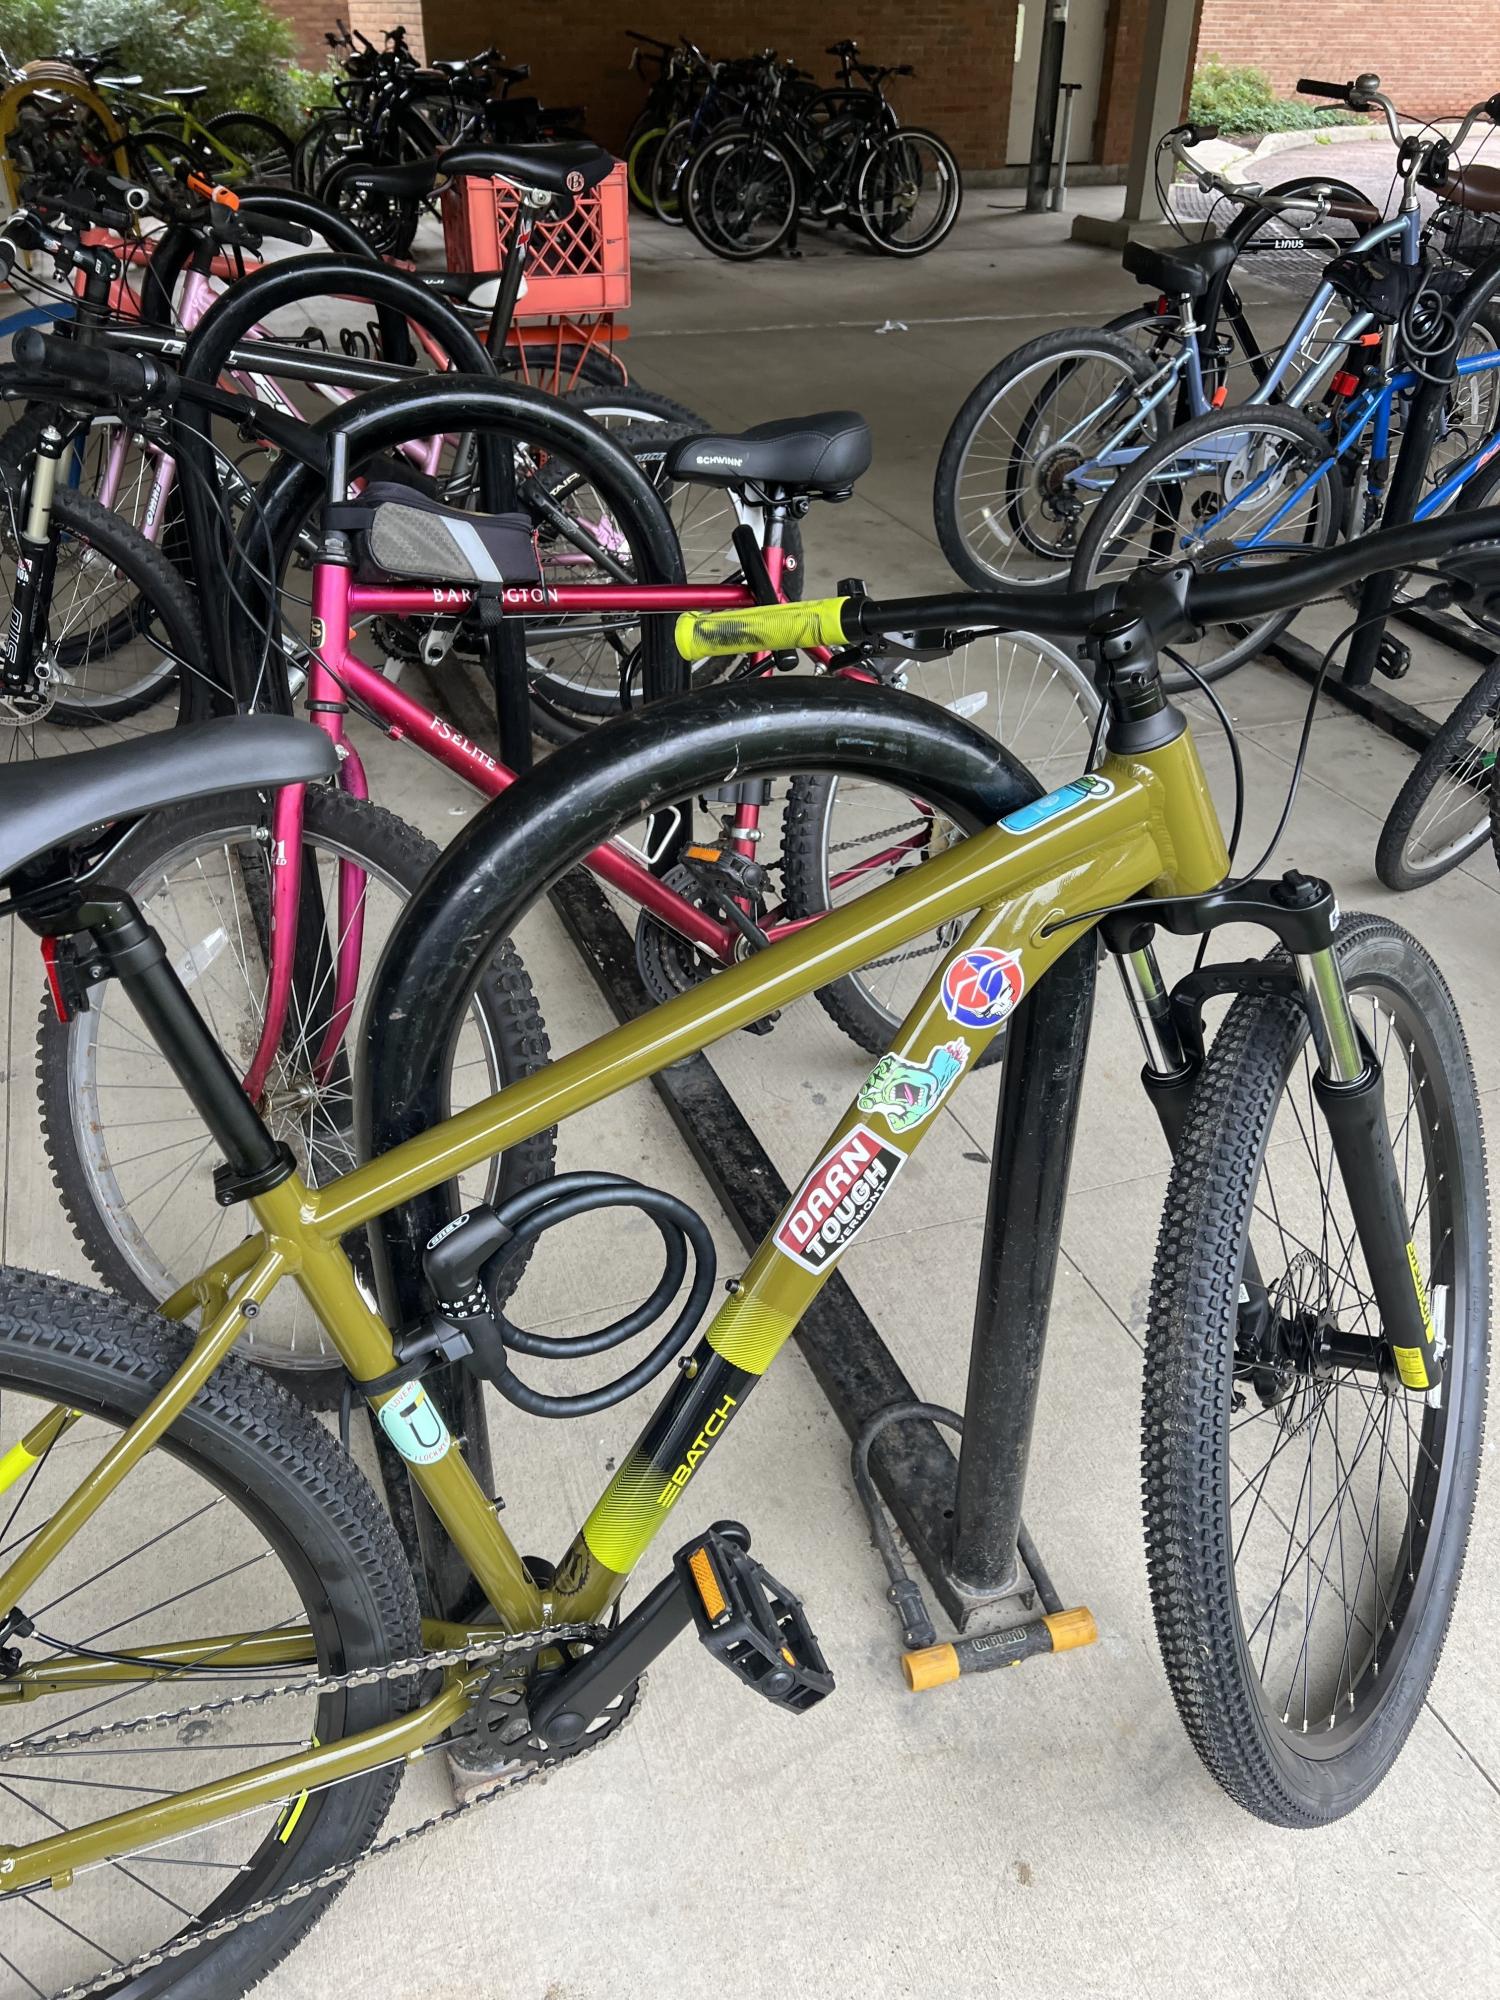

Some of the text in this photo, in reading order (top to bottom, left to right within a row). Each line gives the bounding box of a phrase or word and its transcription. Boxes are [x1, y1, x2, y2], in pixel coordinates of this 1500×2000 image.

[1274, 239, 1304, 249] LINUS
[696, 455, 742, 467] SCHWINN
[788, 1137, 871, 1245] DARN
[805, 1157, 888, 1259] TOUGH
[836, 1181, 886, 1244] VERMONT
[671, 1394, 737, 1487] BATCH
[973, 1627, 1027, 1652] ONGUARD
